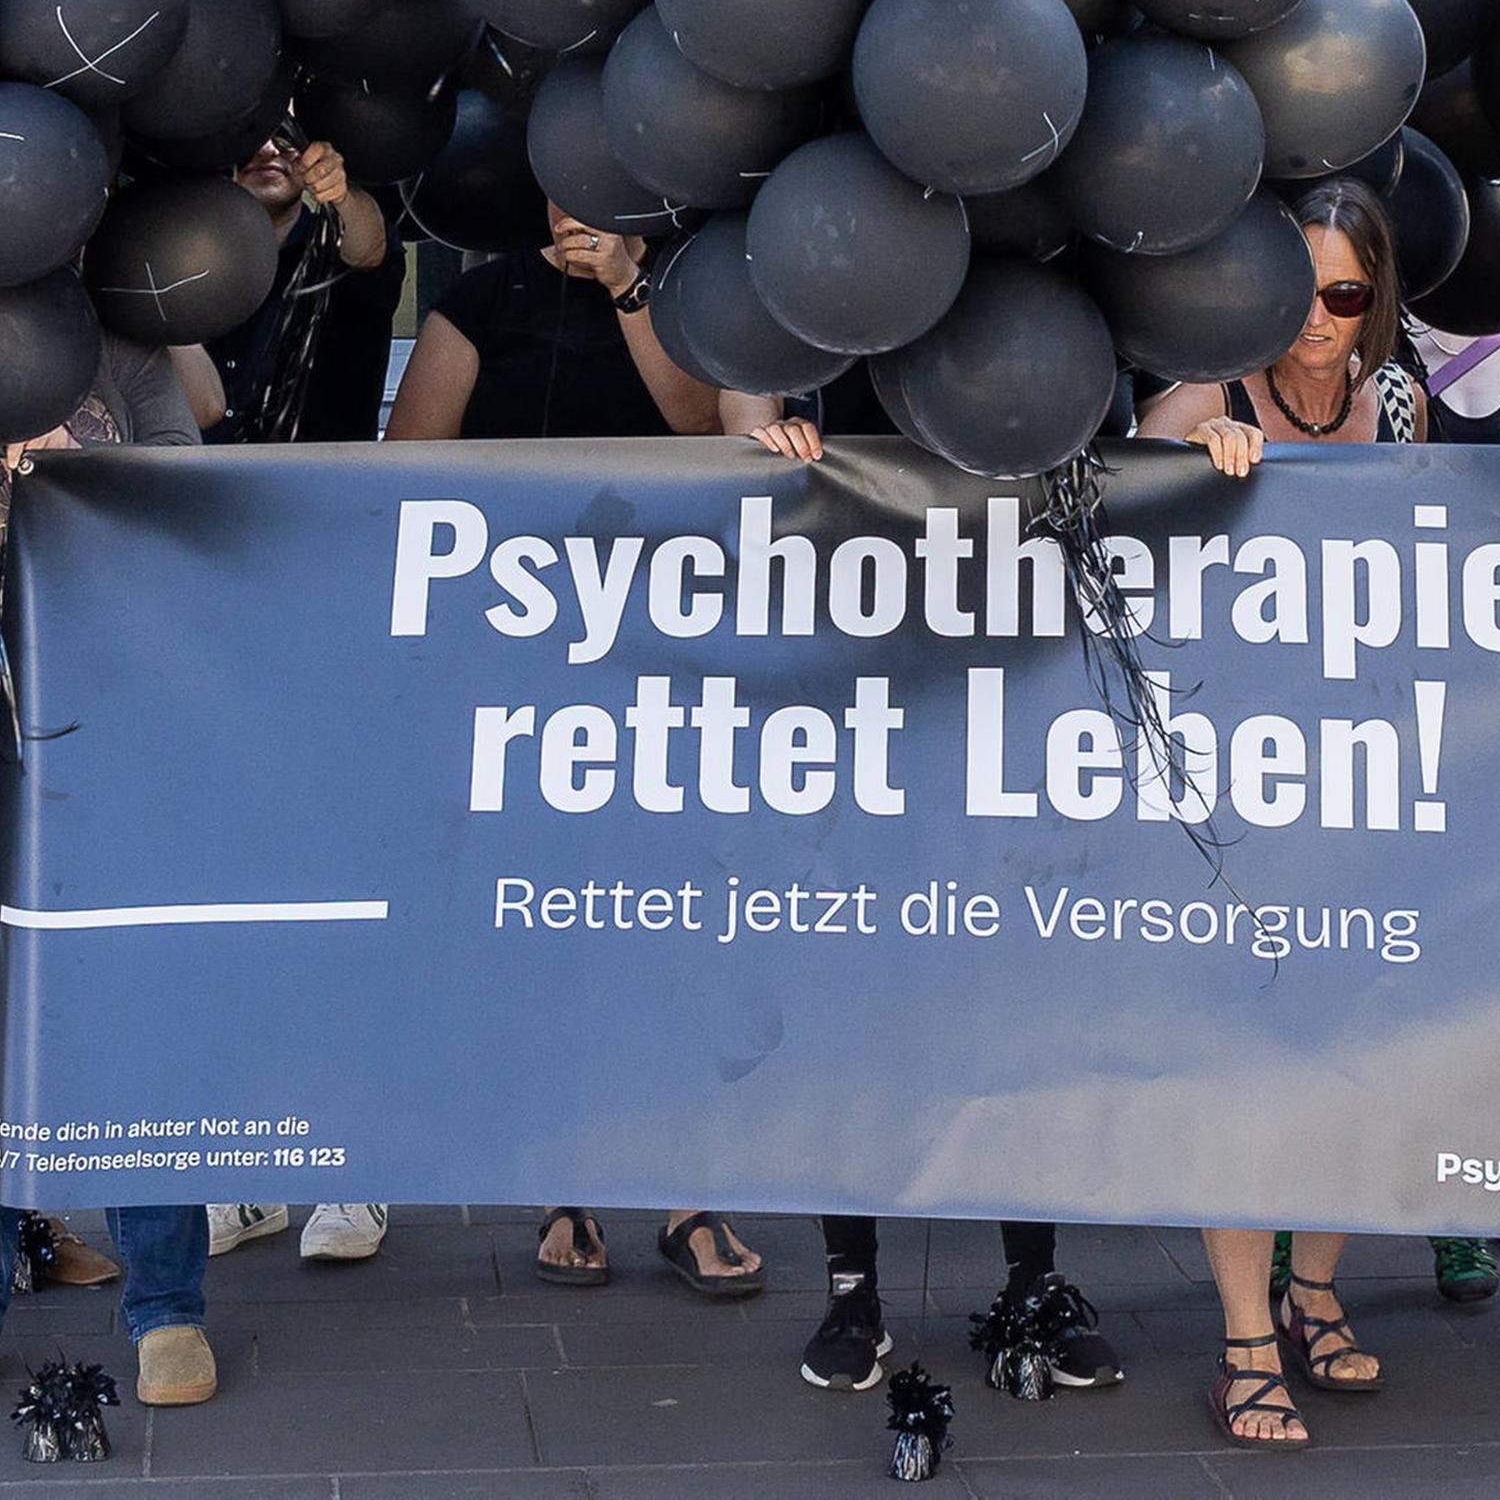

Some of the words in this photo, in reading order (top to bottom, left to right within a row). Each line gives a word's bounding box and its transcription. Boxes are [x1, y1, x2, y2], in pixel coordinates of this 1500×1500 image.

[469, 676, 906, 816] rettet
[965, 666, 1447, 833] Leben!
[494, 878, 703, 931] Rettet
[717, 877, 878, 943] jetzt
[901, 881, 1000, 937] die
[1023, 886, 1422, 963] Versorgung
[0, 1122, 51, 1142] ende
[56, 1122, 99, 1141] dich
[104, 1120, 123, 1139] in
[127, 1119, 196, 1138] akuter
[200, 1117, 239, 1136] Not
[244, 1119, 271, 1136] an
[276, 1116, 310, 1136] die
[0, 1150, 21, 1169] /7
[26, 1149, 201, 1172] Telefonseelsorge
[206, 1149, 269, 1167] unter:
[273, 1147, 305, 1167] 116
[309, 1147, 346, 1167] 123
